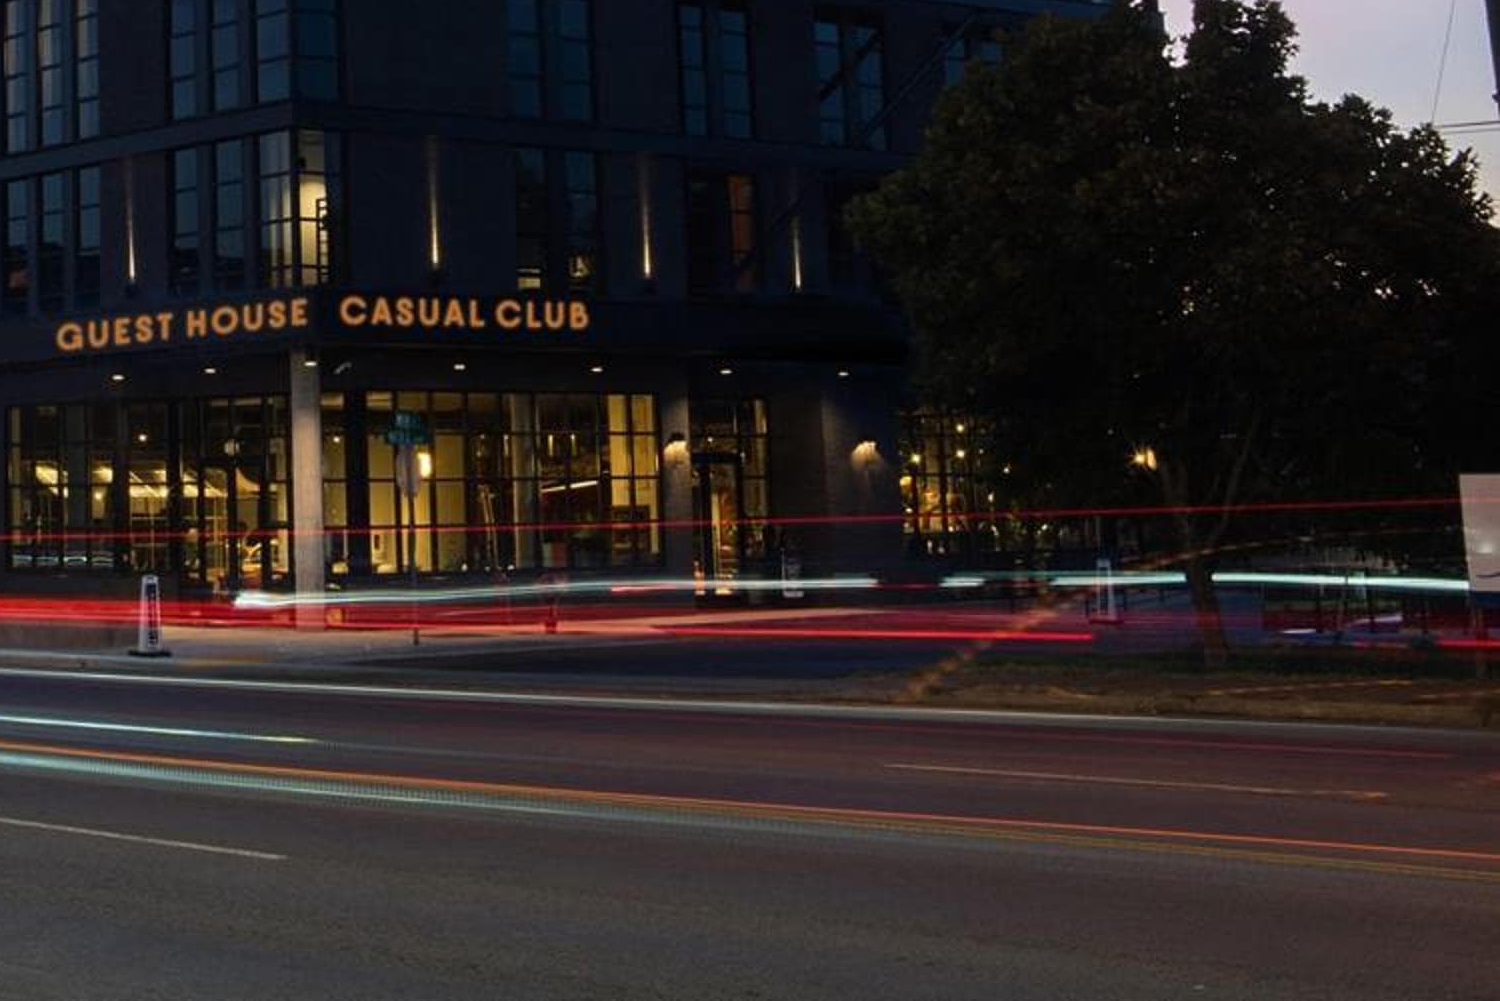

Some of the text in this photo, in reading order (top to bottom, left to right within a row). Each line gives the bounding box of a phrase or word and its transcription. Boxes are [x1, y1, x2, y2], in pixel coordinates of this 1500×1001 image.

[55, 297, 309, 351] GUEST HOUSE
[339, 296, 590, 329] CASUAL CLUB
